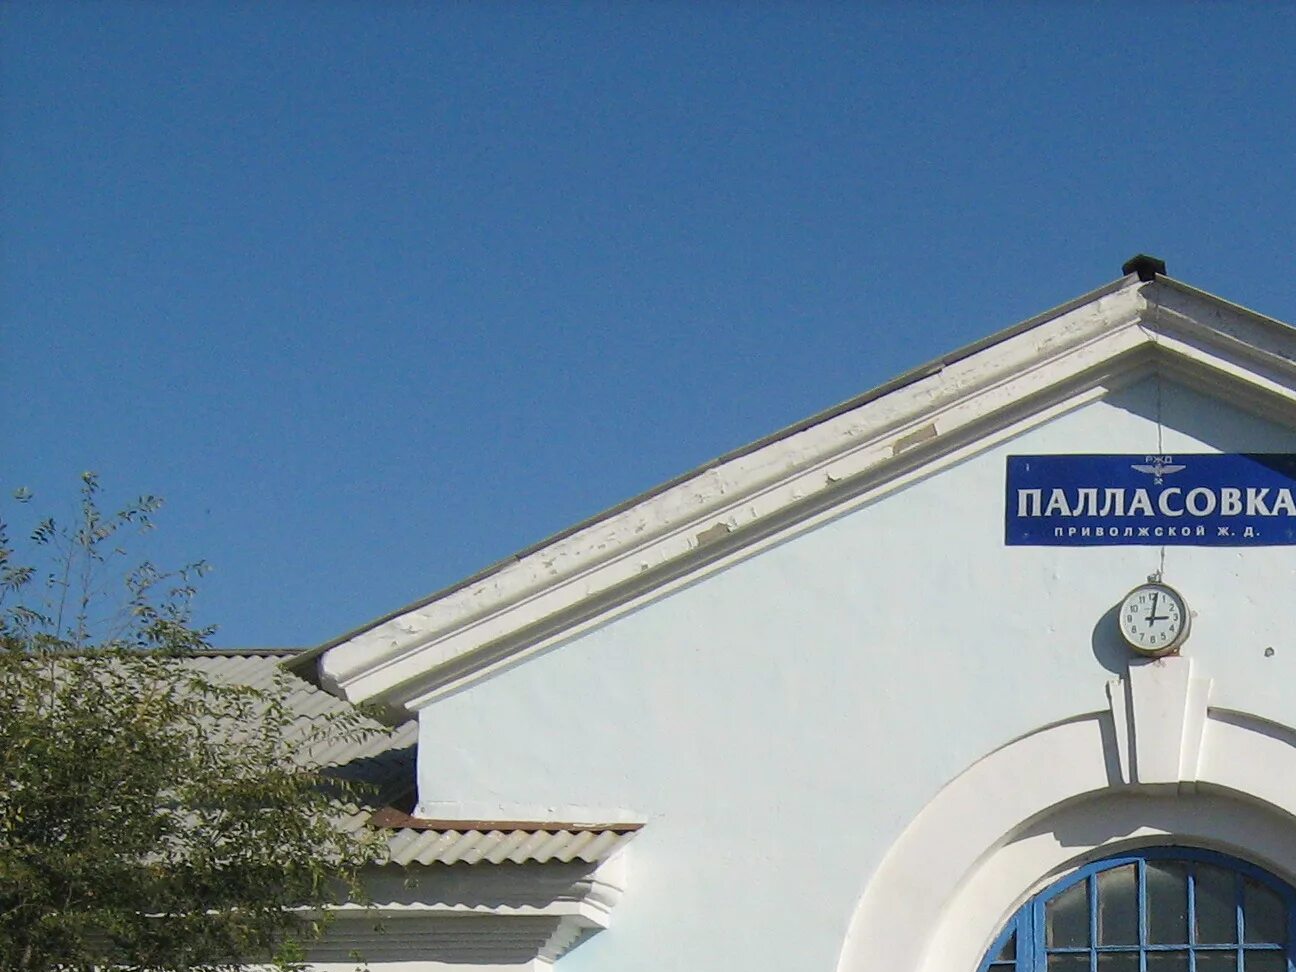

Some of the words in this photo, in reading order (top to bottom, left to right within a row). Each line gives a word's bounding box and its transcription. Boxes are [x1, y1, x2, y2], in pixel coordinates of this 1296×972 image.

[1145, 455, 1173, 464] РЖД
[1054, 525, 1205, 537] ПРИВОЛЖСКОЙ
[1217, 526, 1236, 537] Ж.
[1243, 526, 1261, 538] Д.
